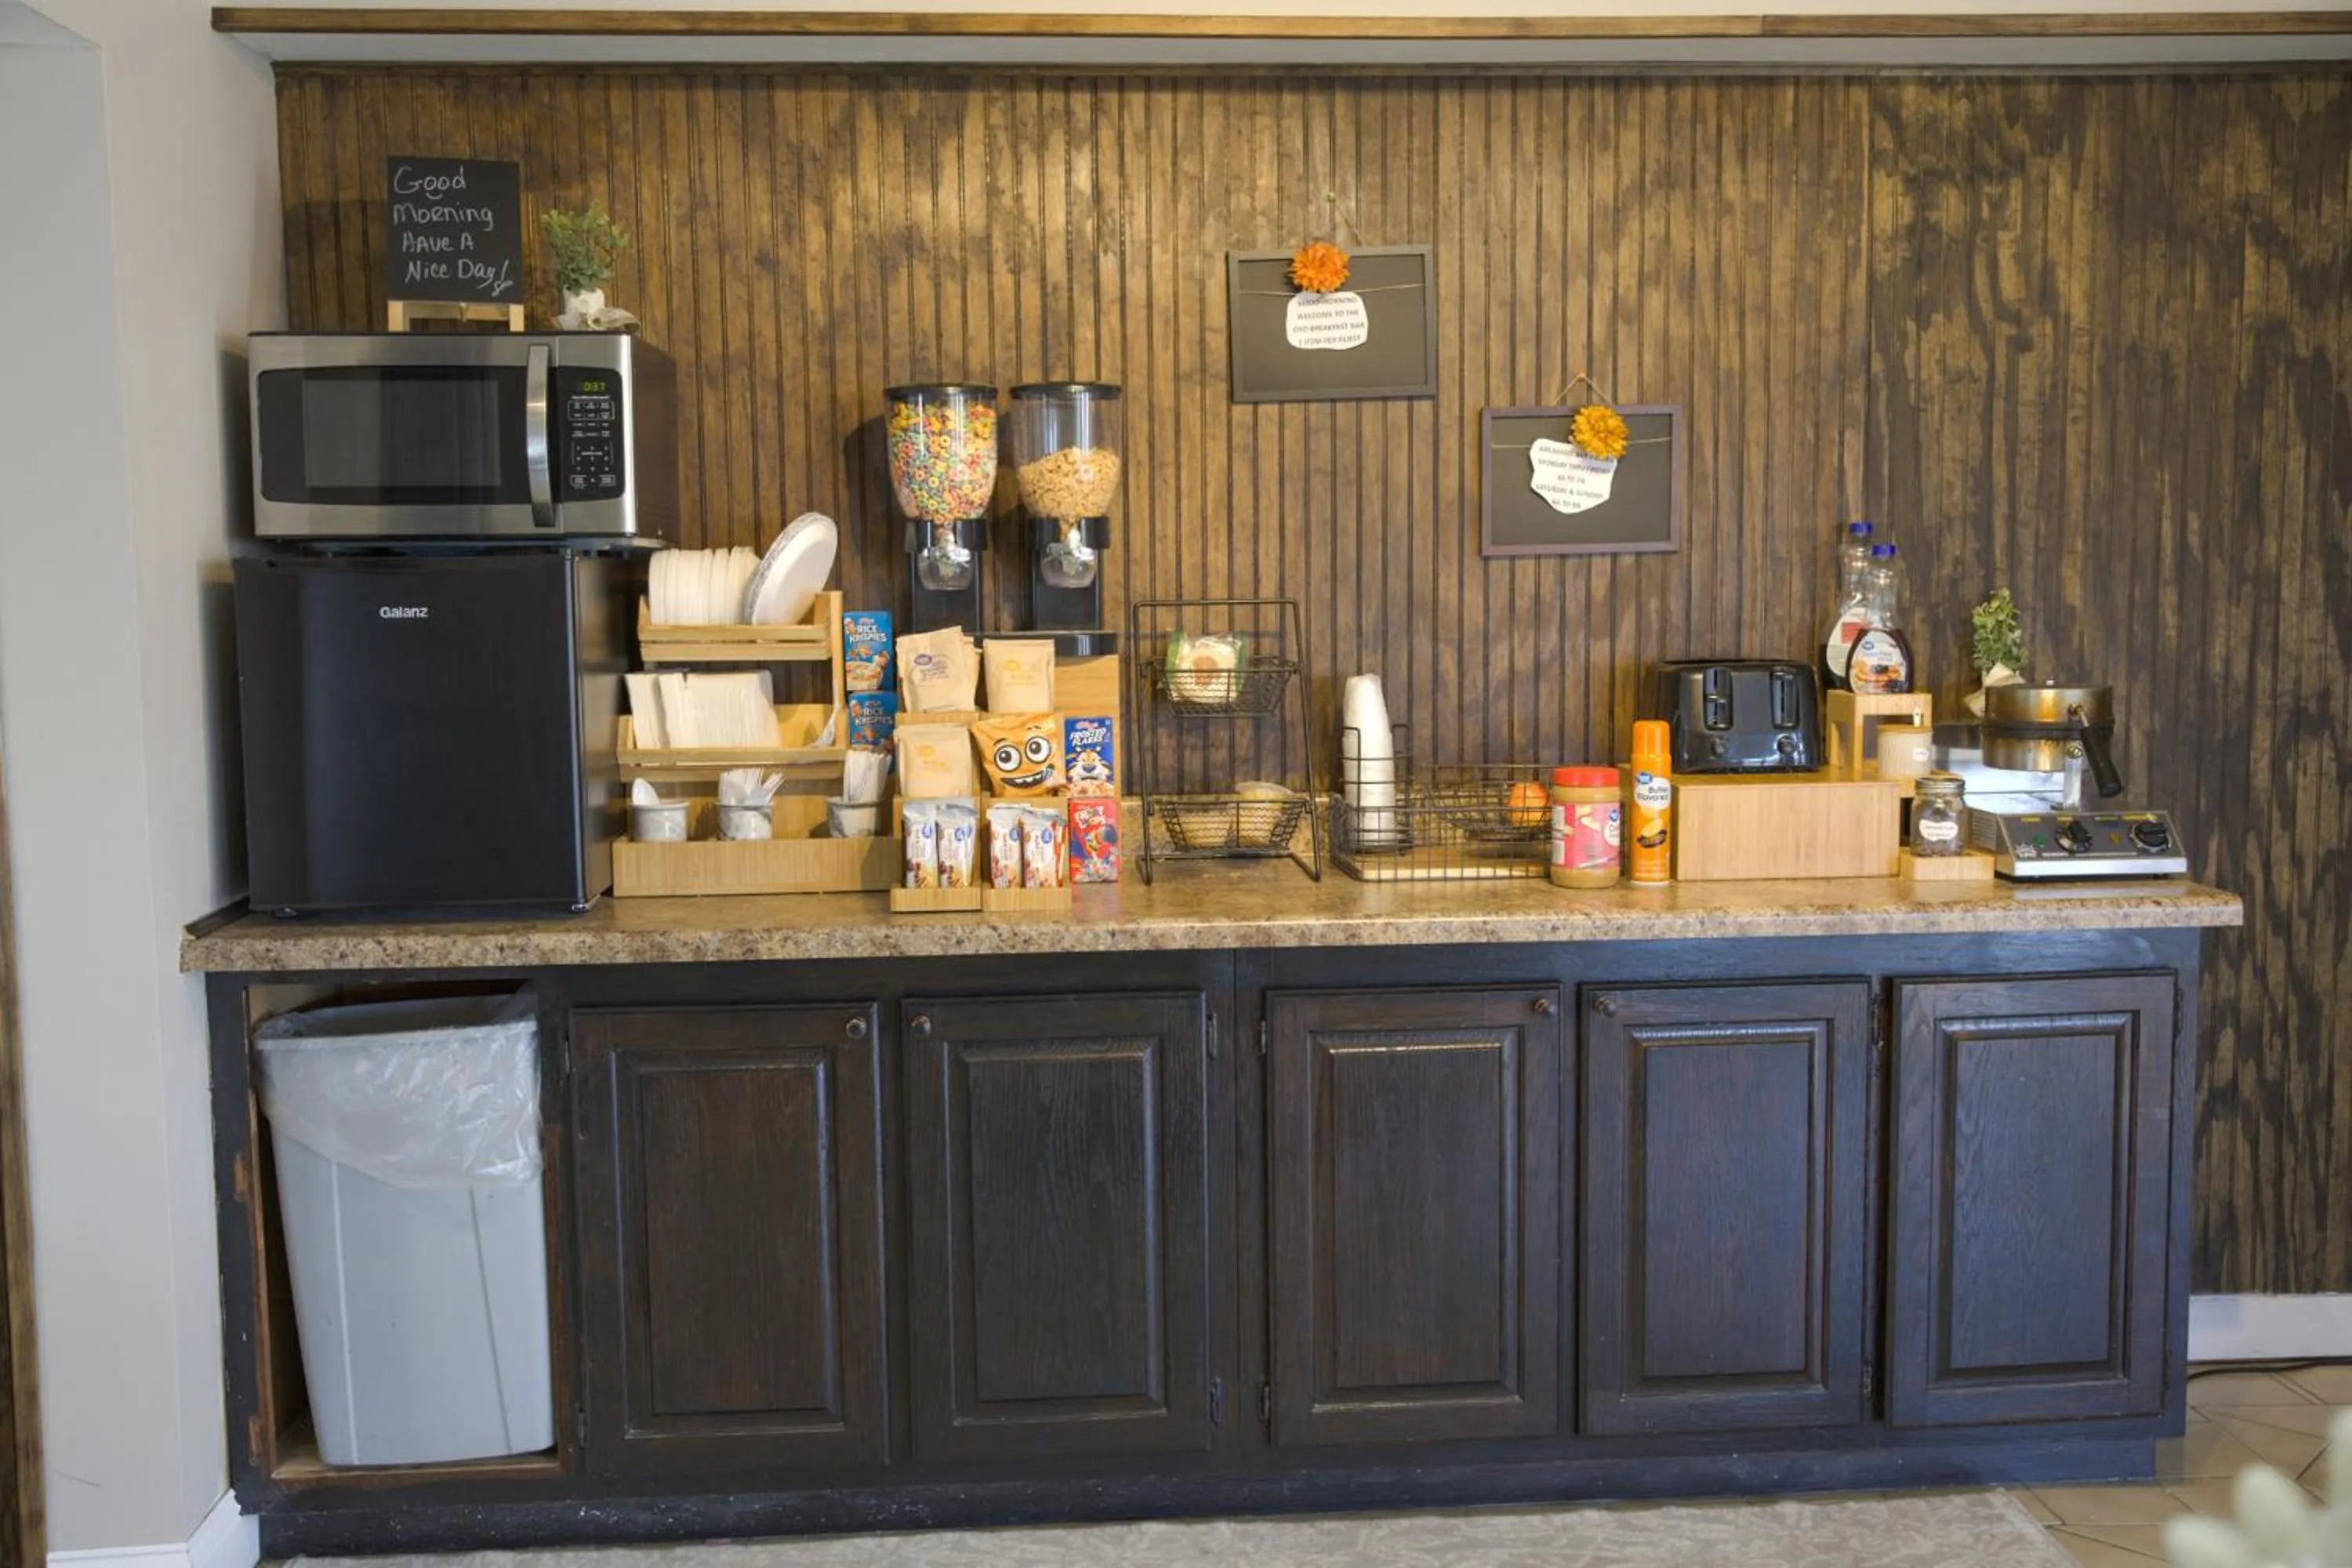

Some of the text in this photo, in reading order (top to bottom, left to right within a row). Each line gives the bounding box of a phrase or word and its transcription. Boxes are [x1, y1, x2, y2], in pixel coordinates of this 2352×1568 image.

[394, 165, 466, 194] Good
[459, 232, 474, 251] A
[379, 606, 429, 619] Galanz
[857, 625, 878, 633] RICE
[850, 632, 887, 643] KRISPIES
